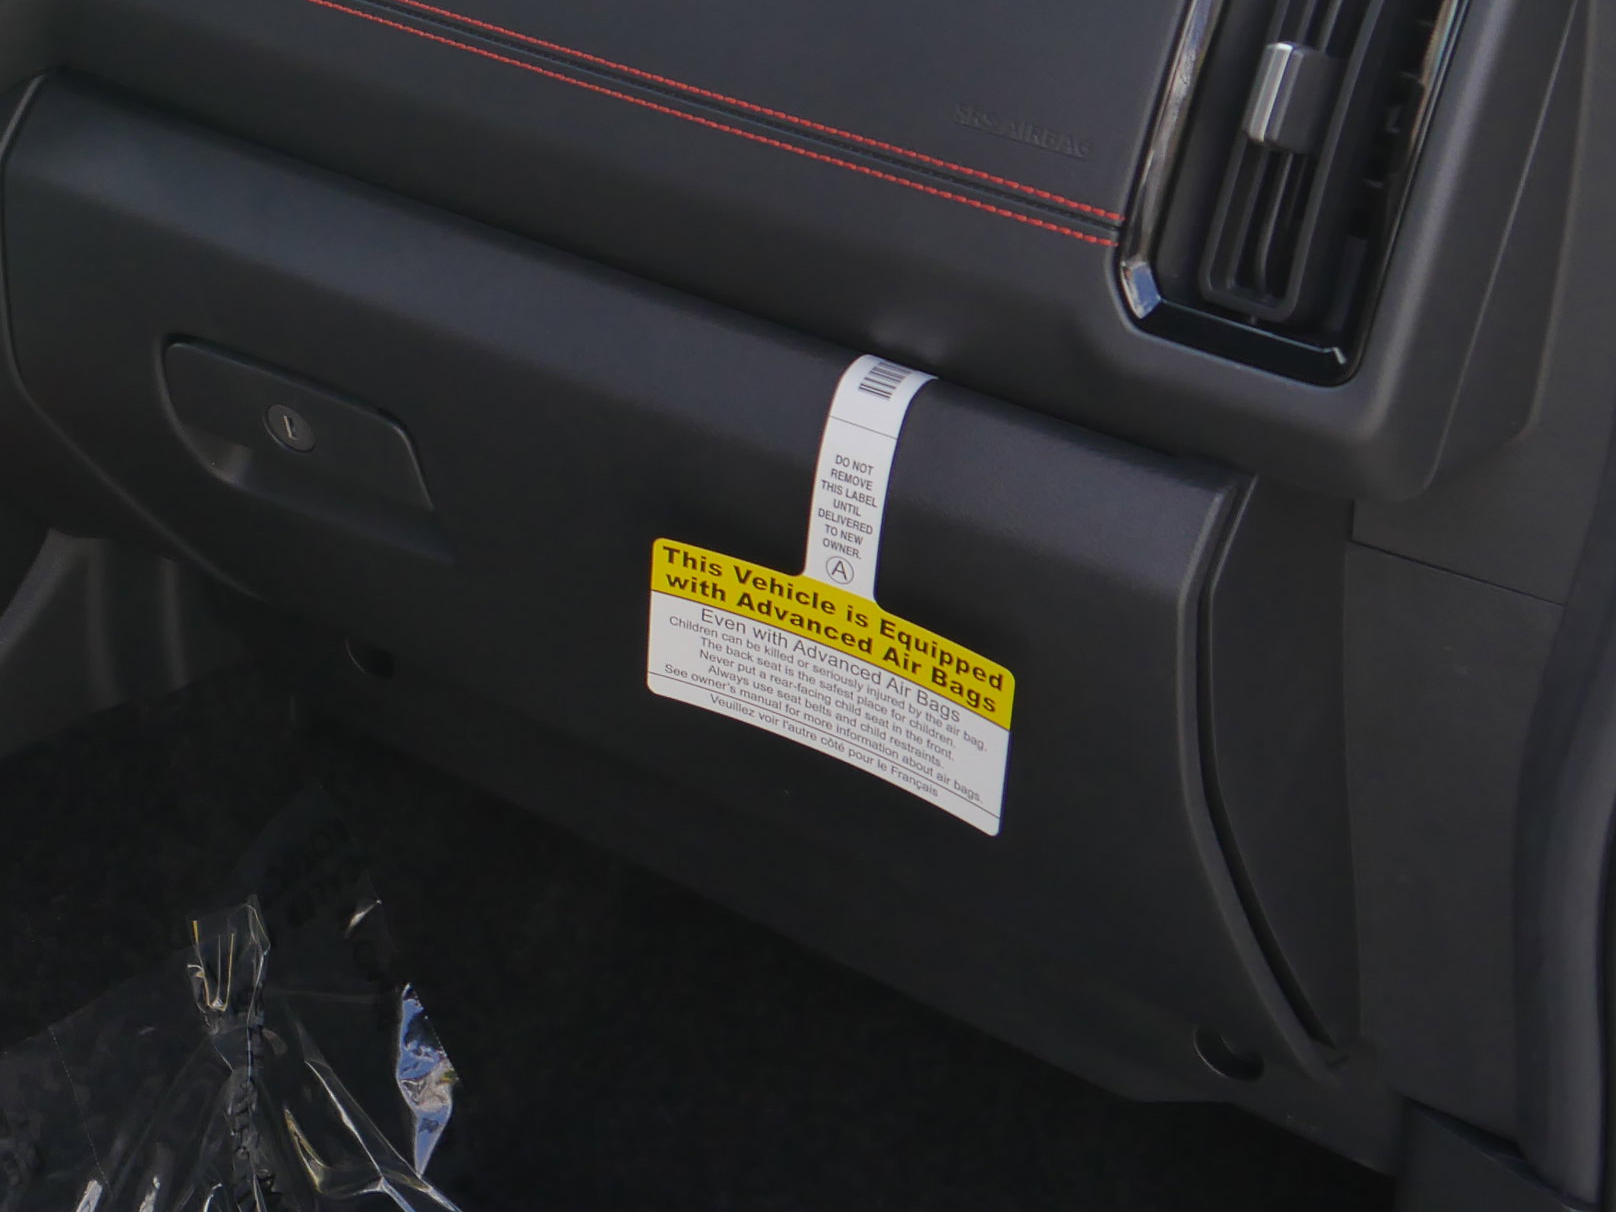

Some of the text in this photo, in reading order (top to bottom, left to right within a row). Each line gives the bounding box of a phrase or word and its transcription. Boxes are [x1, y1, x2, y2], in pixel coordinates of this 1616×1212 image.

[821, 480, 878, 508] THIS LABEL
[831, 468, 873, 490] REMOVE
[833, 498, 861, 517] UNTIL
[835, 454, 874, 476] DO NOT
[818, 508, 873, 535] DELIVERED
[823, 538, 862, 560] OWNER.
[824, 524, 863, 546] TO NEW
[831, 560, 847, 580] A
[663, 545, 1003, 692] This Vehicle is Equipped
[666, 573, 996, 713] with Advanced Air Bags
[701, 608, 960, 722] Even with Advanced Air Bags
[665, 664, 983, 804] See owner's manual for more information about air bags.
[669, 615, 987, 752] Children can be killed or seriously injured by the air bag.
[700, 649, 954, 761] Never put a rear-facing child seat in the front.
[701, 637, 956, 748] The back seat is the safest place for children.
[708, 665, 944, 769] Always use seat belts and child restraints.
[710, 694, 938, 797] Veuillez voir l'autre côté pour le Français
